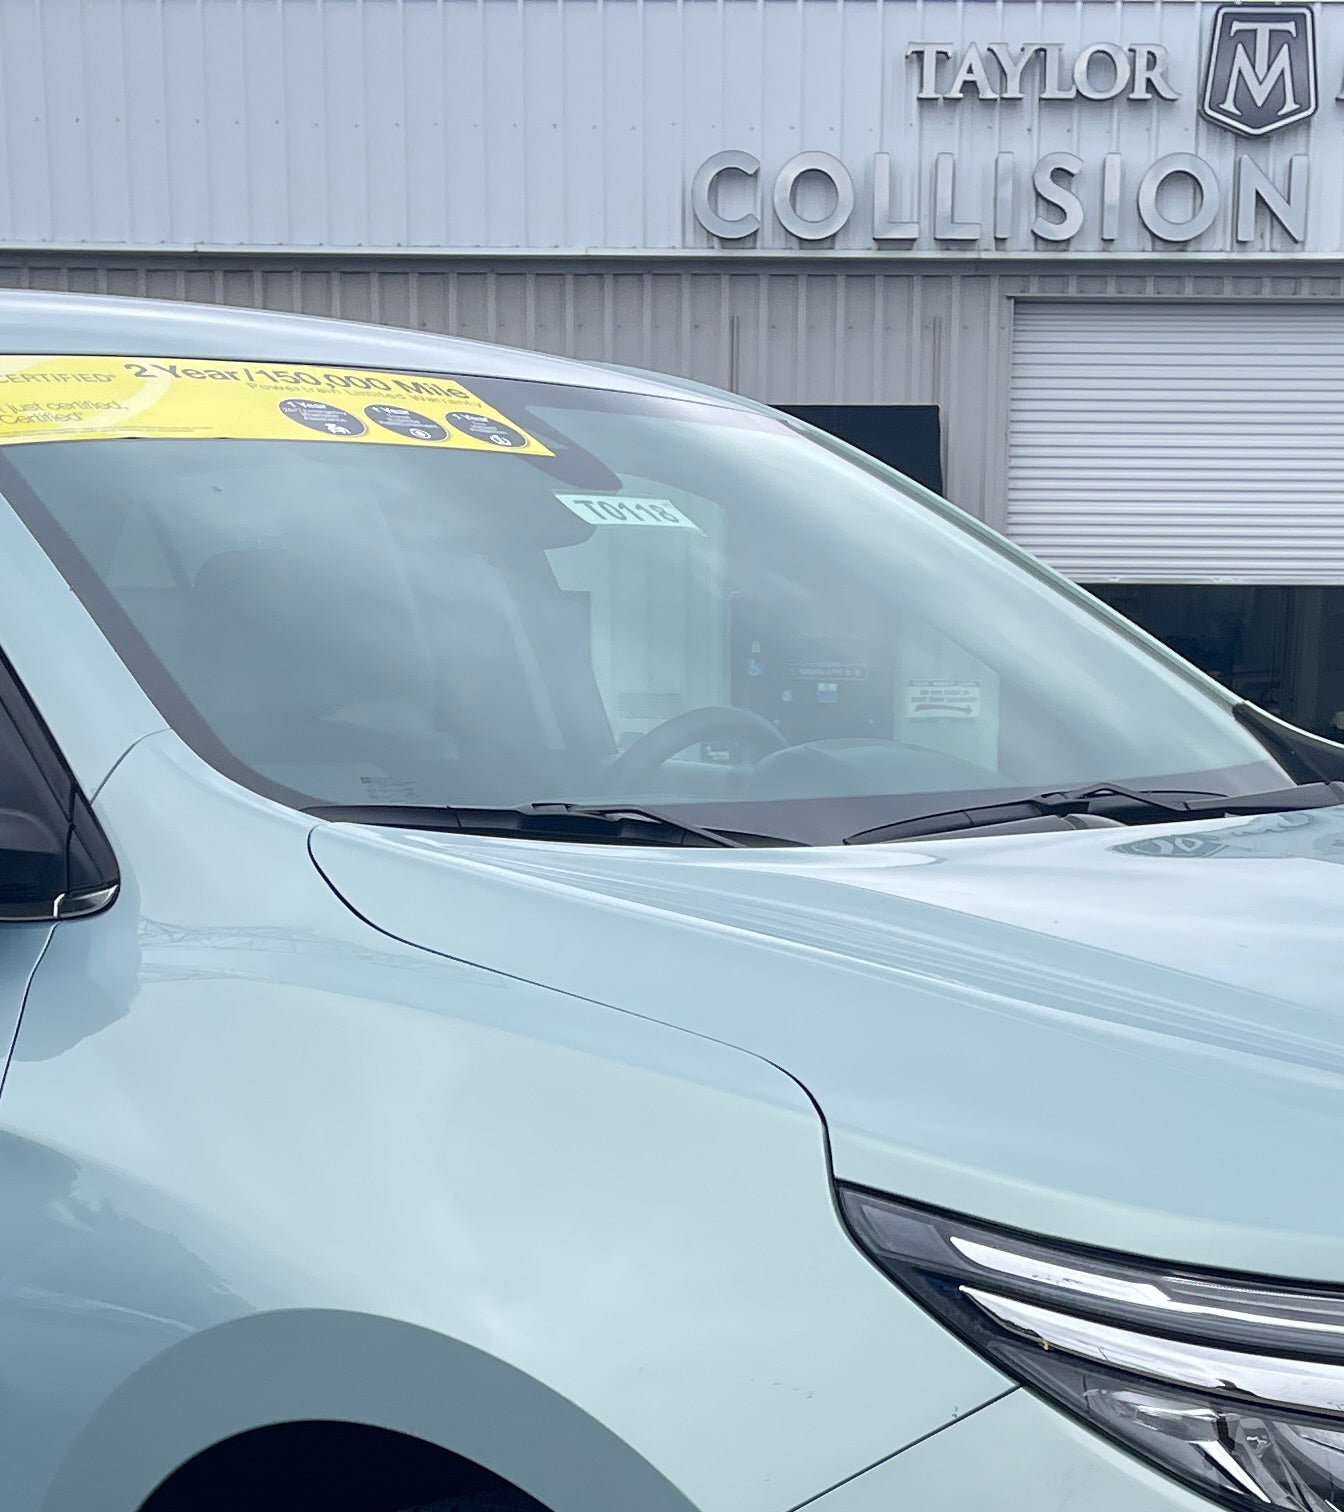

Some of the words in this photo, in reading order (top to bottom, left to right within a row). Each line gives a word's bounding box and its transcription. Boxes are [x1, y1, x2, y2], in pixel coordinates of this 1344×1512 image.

[905, 41, 1183, 101] TAYLOR
[690, 148, 1309, 244] COLLISION
[124, 362, 154, 379] 2
[392, 378, 471, 400] Mile
[7, 401, 46, 414] just
[573, 500, 681, 524] T0118
